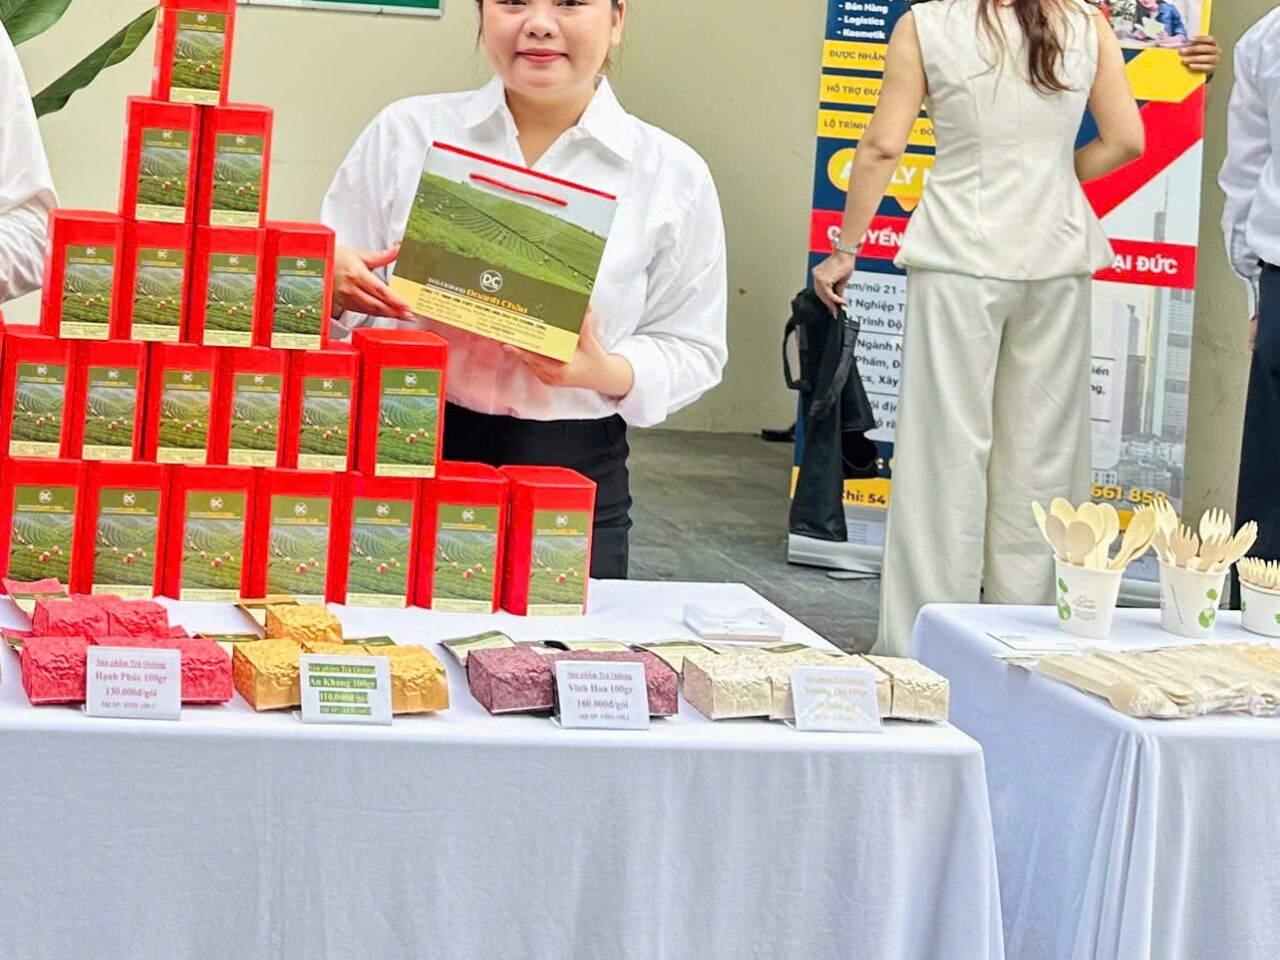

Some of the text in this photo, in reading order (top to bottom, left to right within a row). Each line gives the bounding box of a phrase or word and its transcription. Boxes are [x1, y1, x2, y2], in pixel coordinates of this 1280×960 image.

[844, 15, 884, 26] Logistics
[843, 28, 885, 38] Kosmetik
[1136, 253, 1178, 274] ĐỨC
[482, 274, 500, 287] DC
[884, 285, 896, 294] 21
[856, 300, 894, 312] Nghiệp
[868, 495, 886, 505] 54
